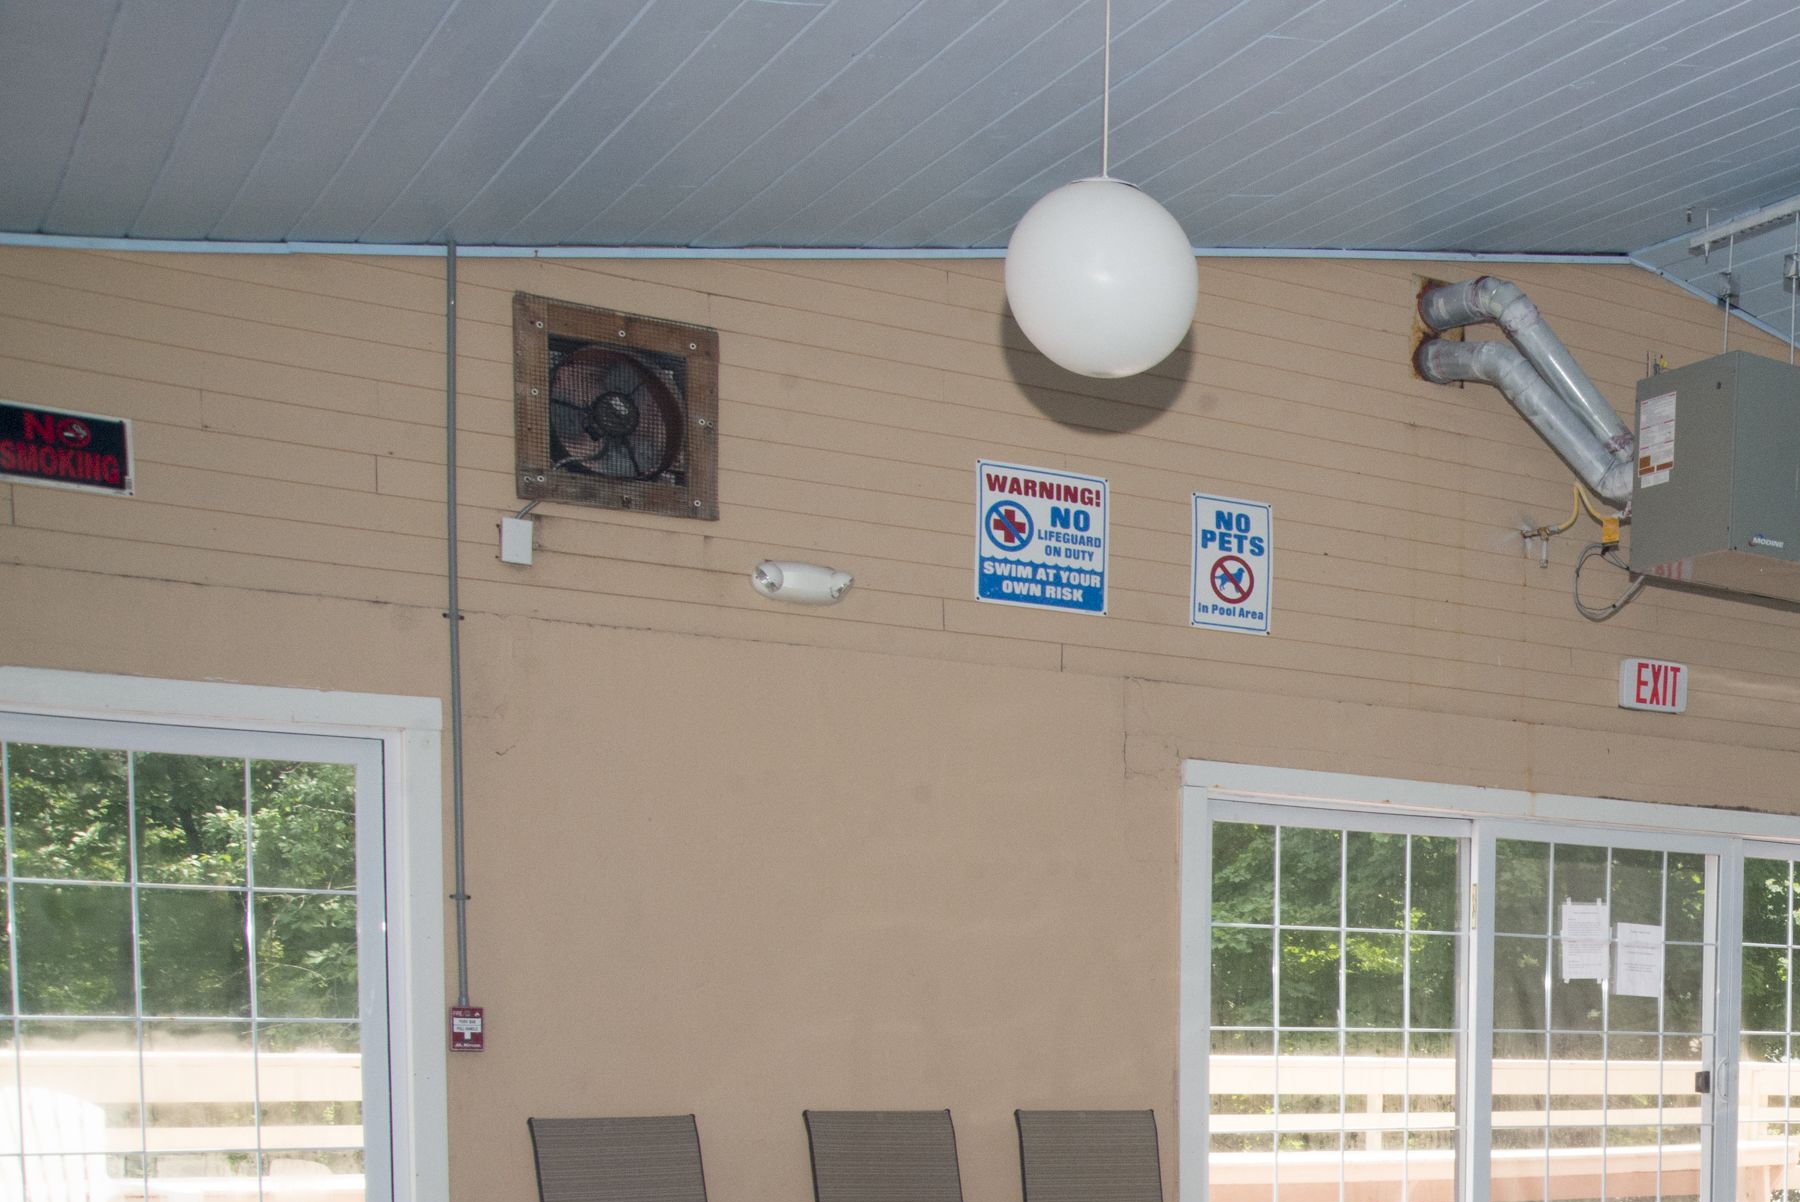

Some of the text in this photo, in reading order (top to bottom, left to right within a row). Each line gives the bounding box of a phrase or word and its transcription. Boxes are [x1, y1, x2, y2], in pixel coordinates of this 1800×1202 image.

[0, 438, 119, 485] SMOKING
[986, 473, 1101, 508] WARNING!
[1050, 506, 1091, 532] NO
[1215, 510, 1251, 534] NO
[1037, 529, 1102, 548] LIFEGUARD
[1201, 528, 1265, 557] PETS
[1044, 545, 1095, 562] ON DUTY
[983, 560, 1101, 588] SWIM AT YOUR
[1002, 579, 1084, 602] OWN RISK
[1198, 602, 1264, 620] In Pool Area
[1636, 662, 1681, 707] EXIT
